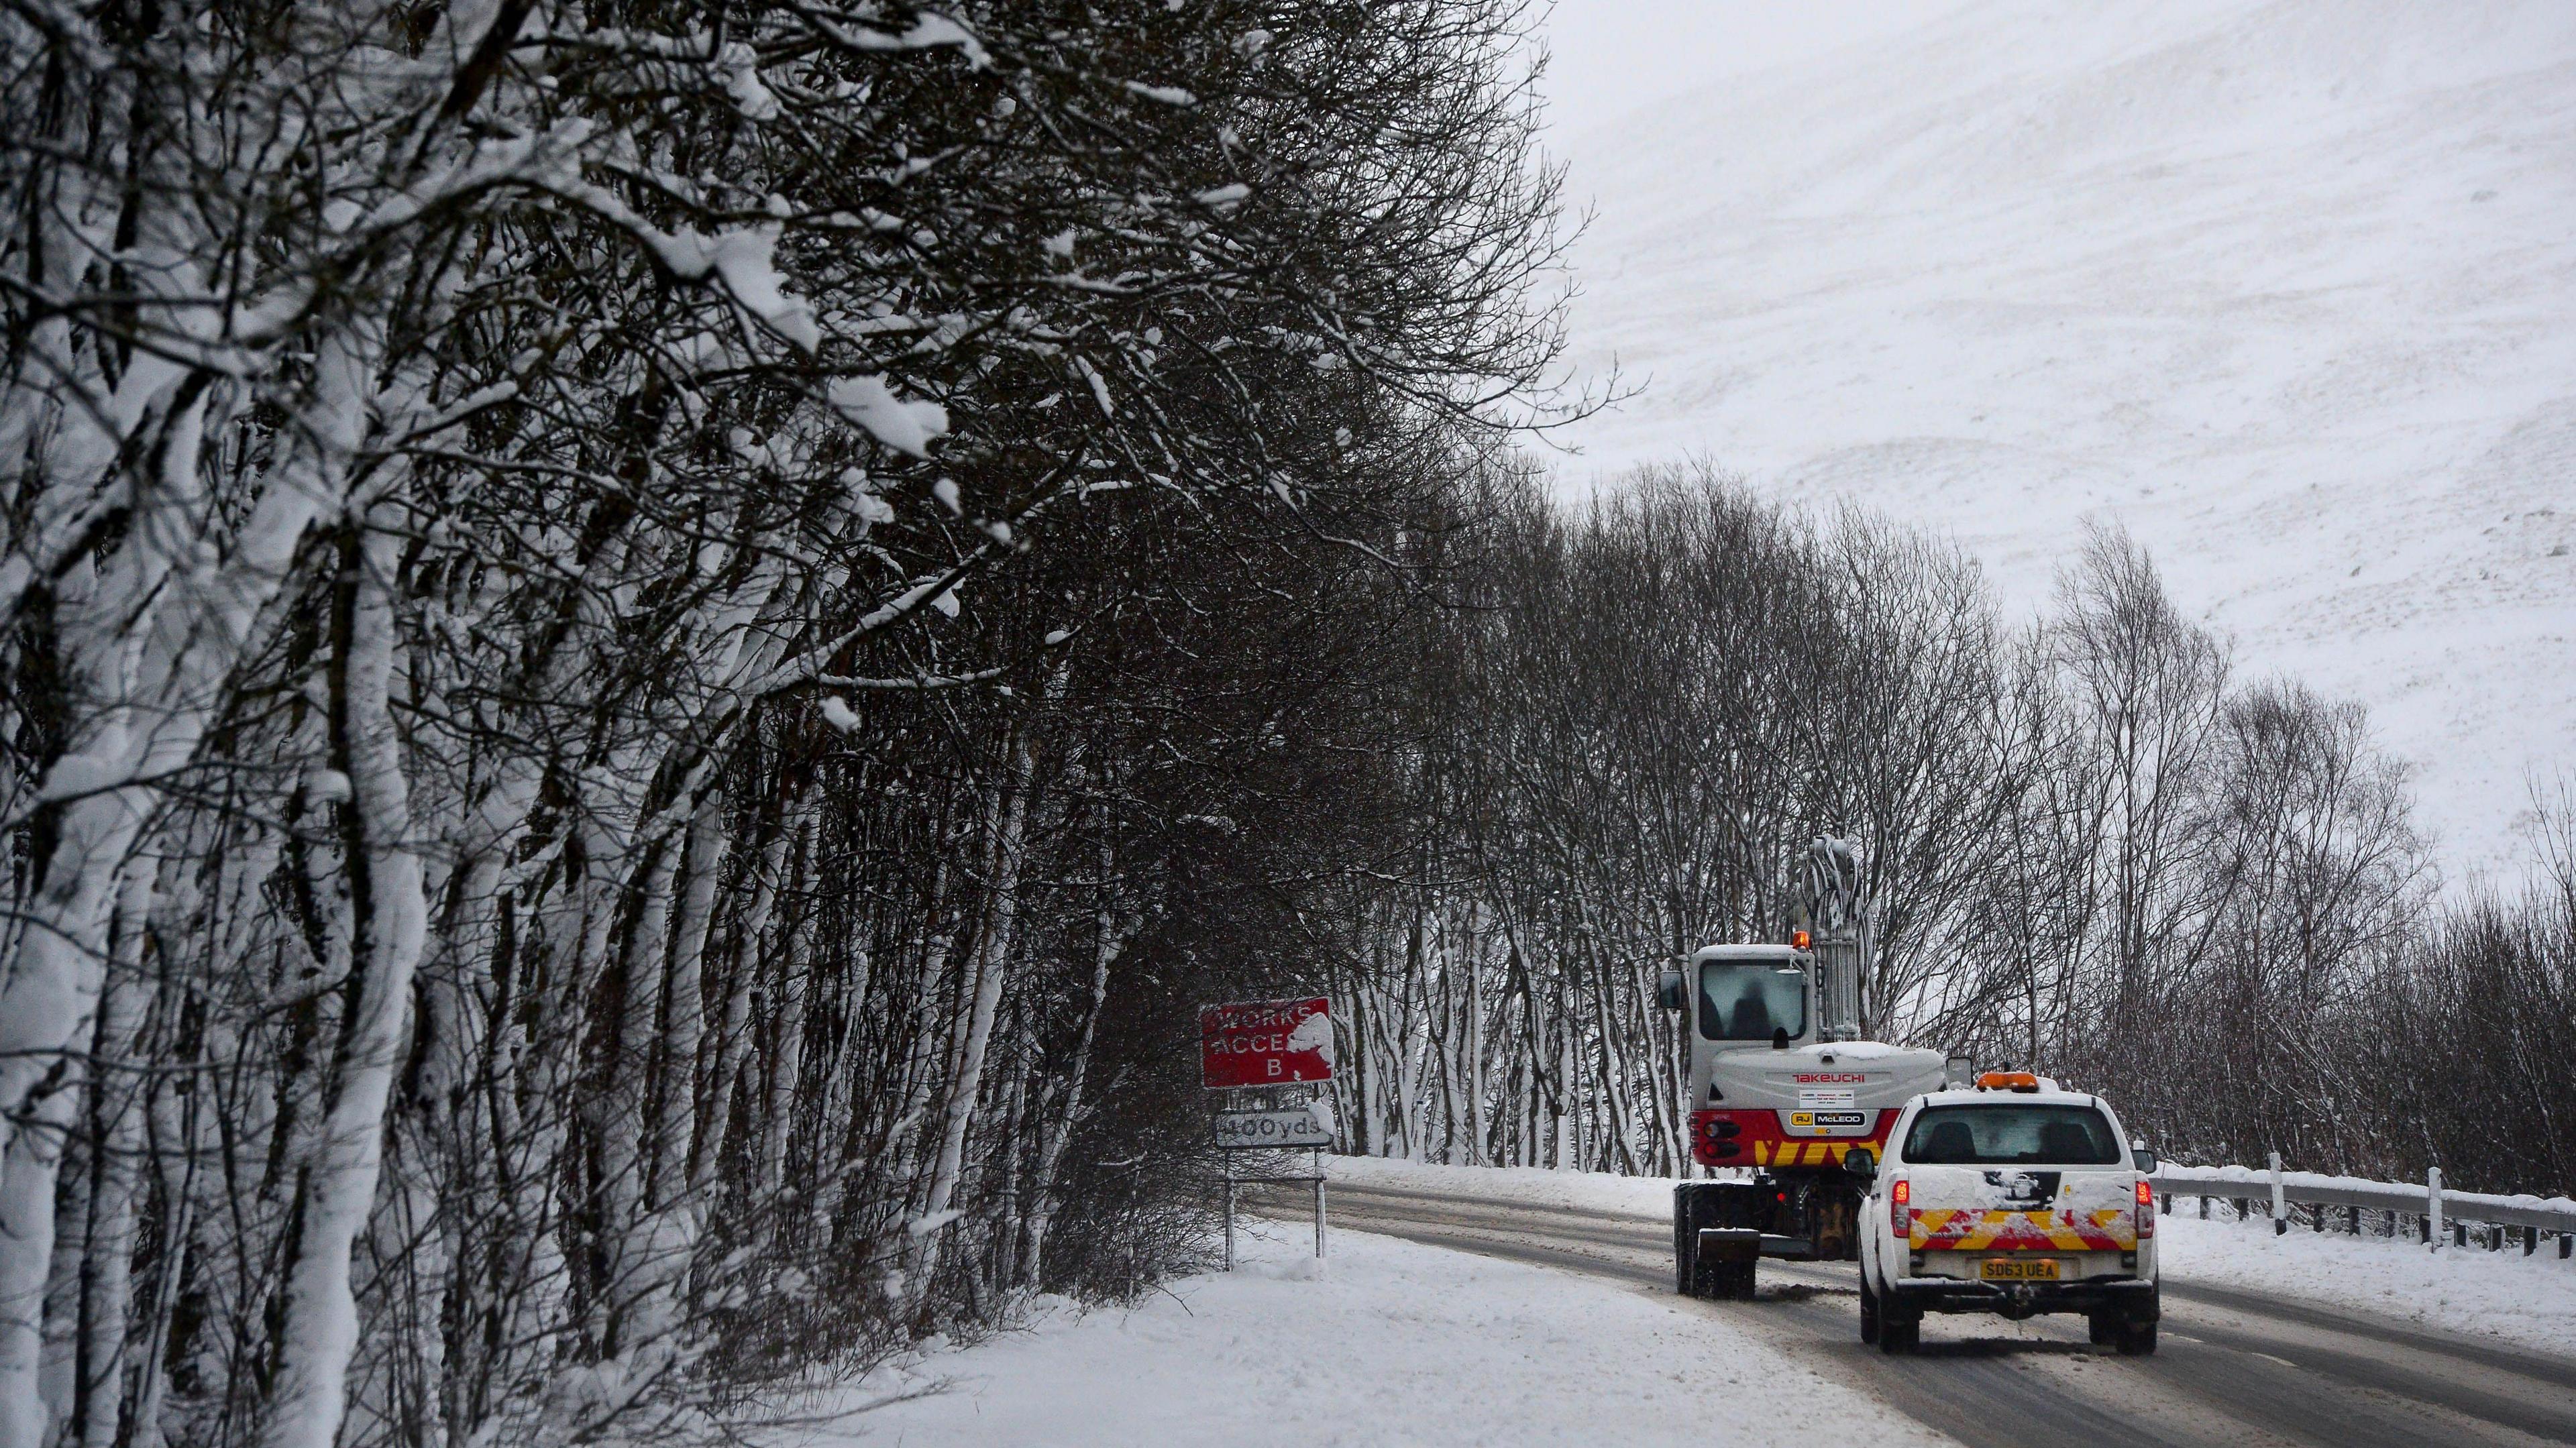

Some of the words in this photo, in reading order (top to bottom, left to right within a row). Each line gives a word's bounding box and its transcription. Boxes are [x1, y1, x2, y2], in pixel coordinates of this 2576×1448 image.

[1210, 1034, 1301, 1054] ACCE
[1267, 1058, 1282, 1076] B
[1986, 1264, 2023, 1276] SD63
[2027, 1264, 2054, 1277] UEA
